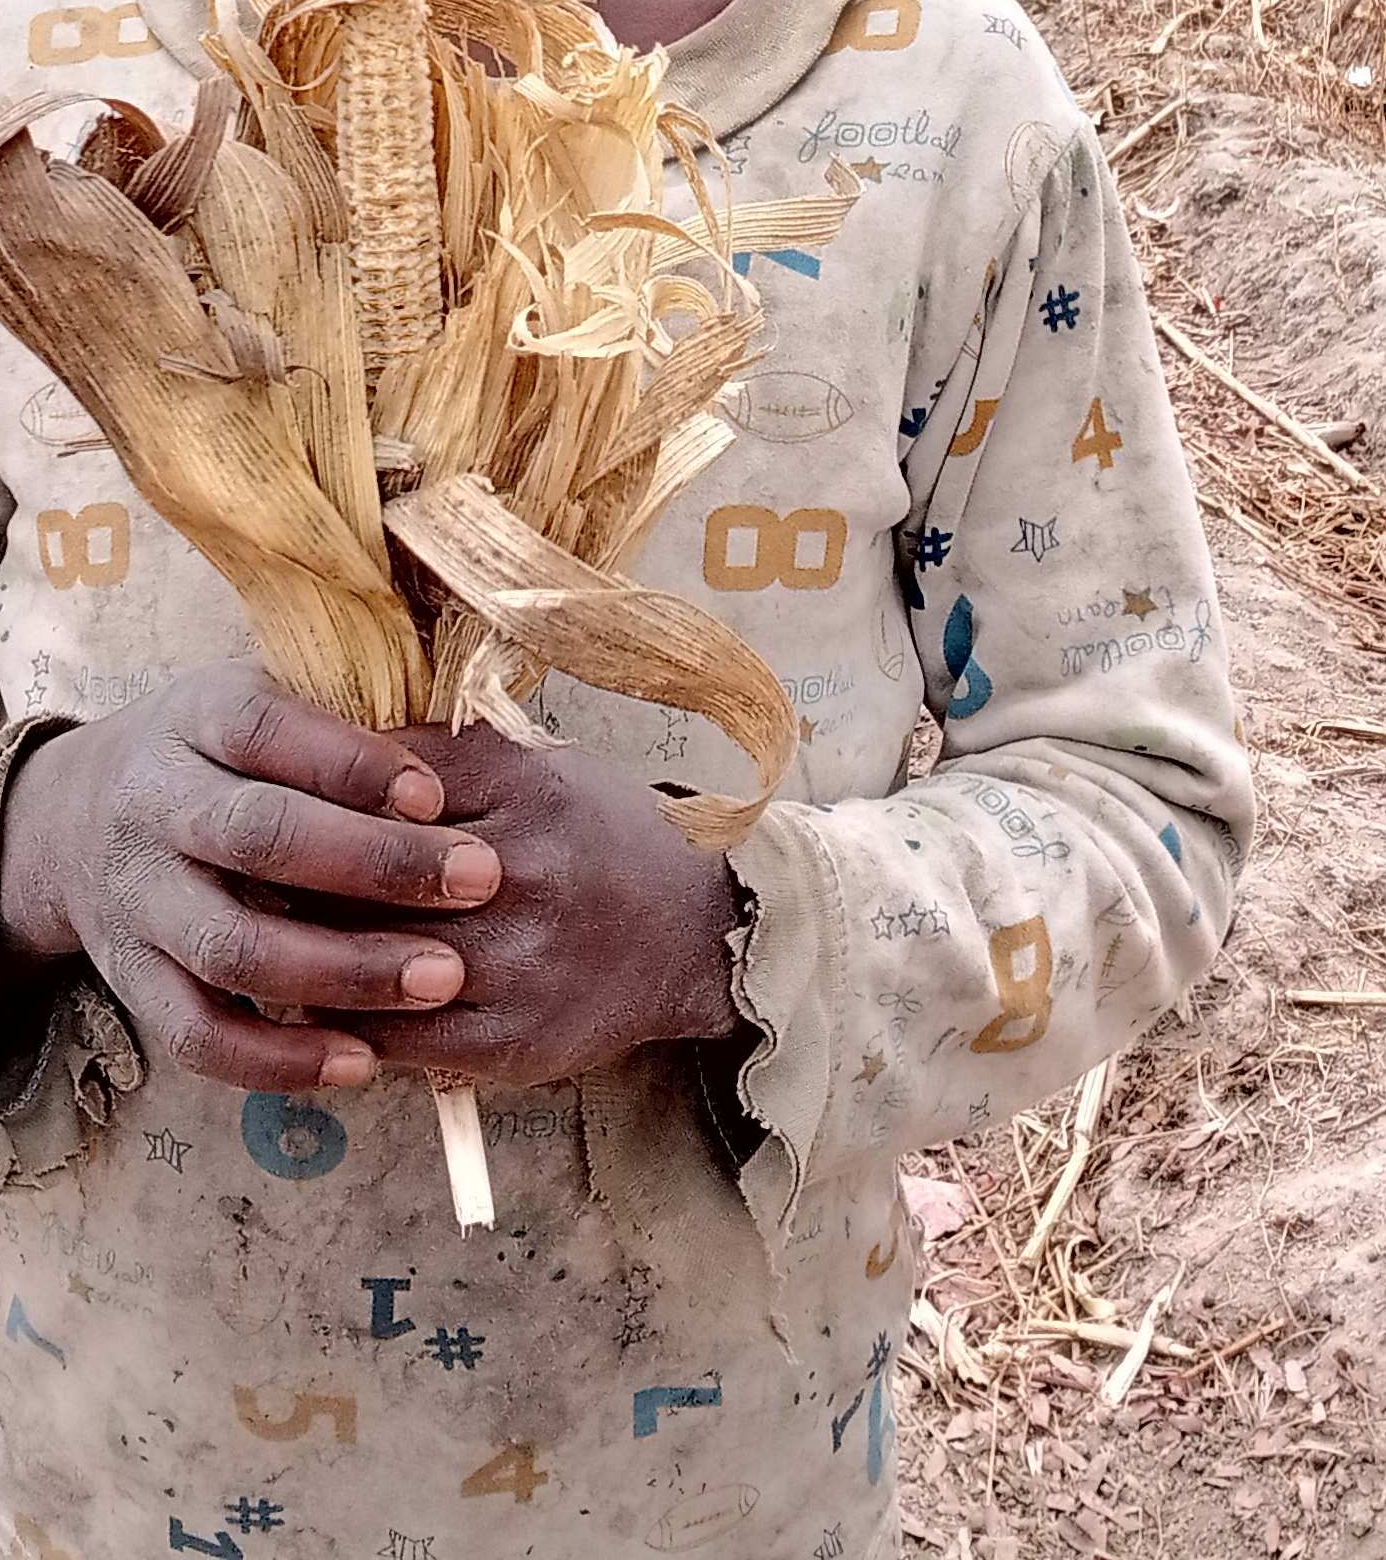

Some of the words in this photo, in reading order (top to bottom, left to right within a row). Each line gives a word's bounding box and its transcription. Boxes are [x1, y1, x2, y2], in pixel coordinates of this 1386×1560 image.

[28, 2, 163, 66] 8
[1070, 397, 1122, 469] 4
[36, 503, 130, 589] 8
[703, 506, 848, 591] 8
[233, 1384, 358, 1444] 5
[460, 1441, 549, 1503] 4
